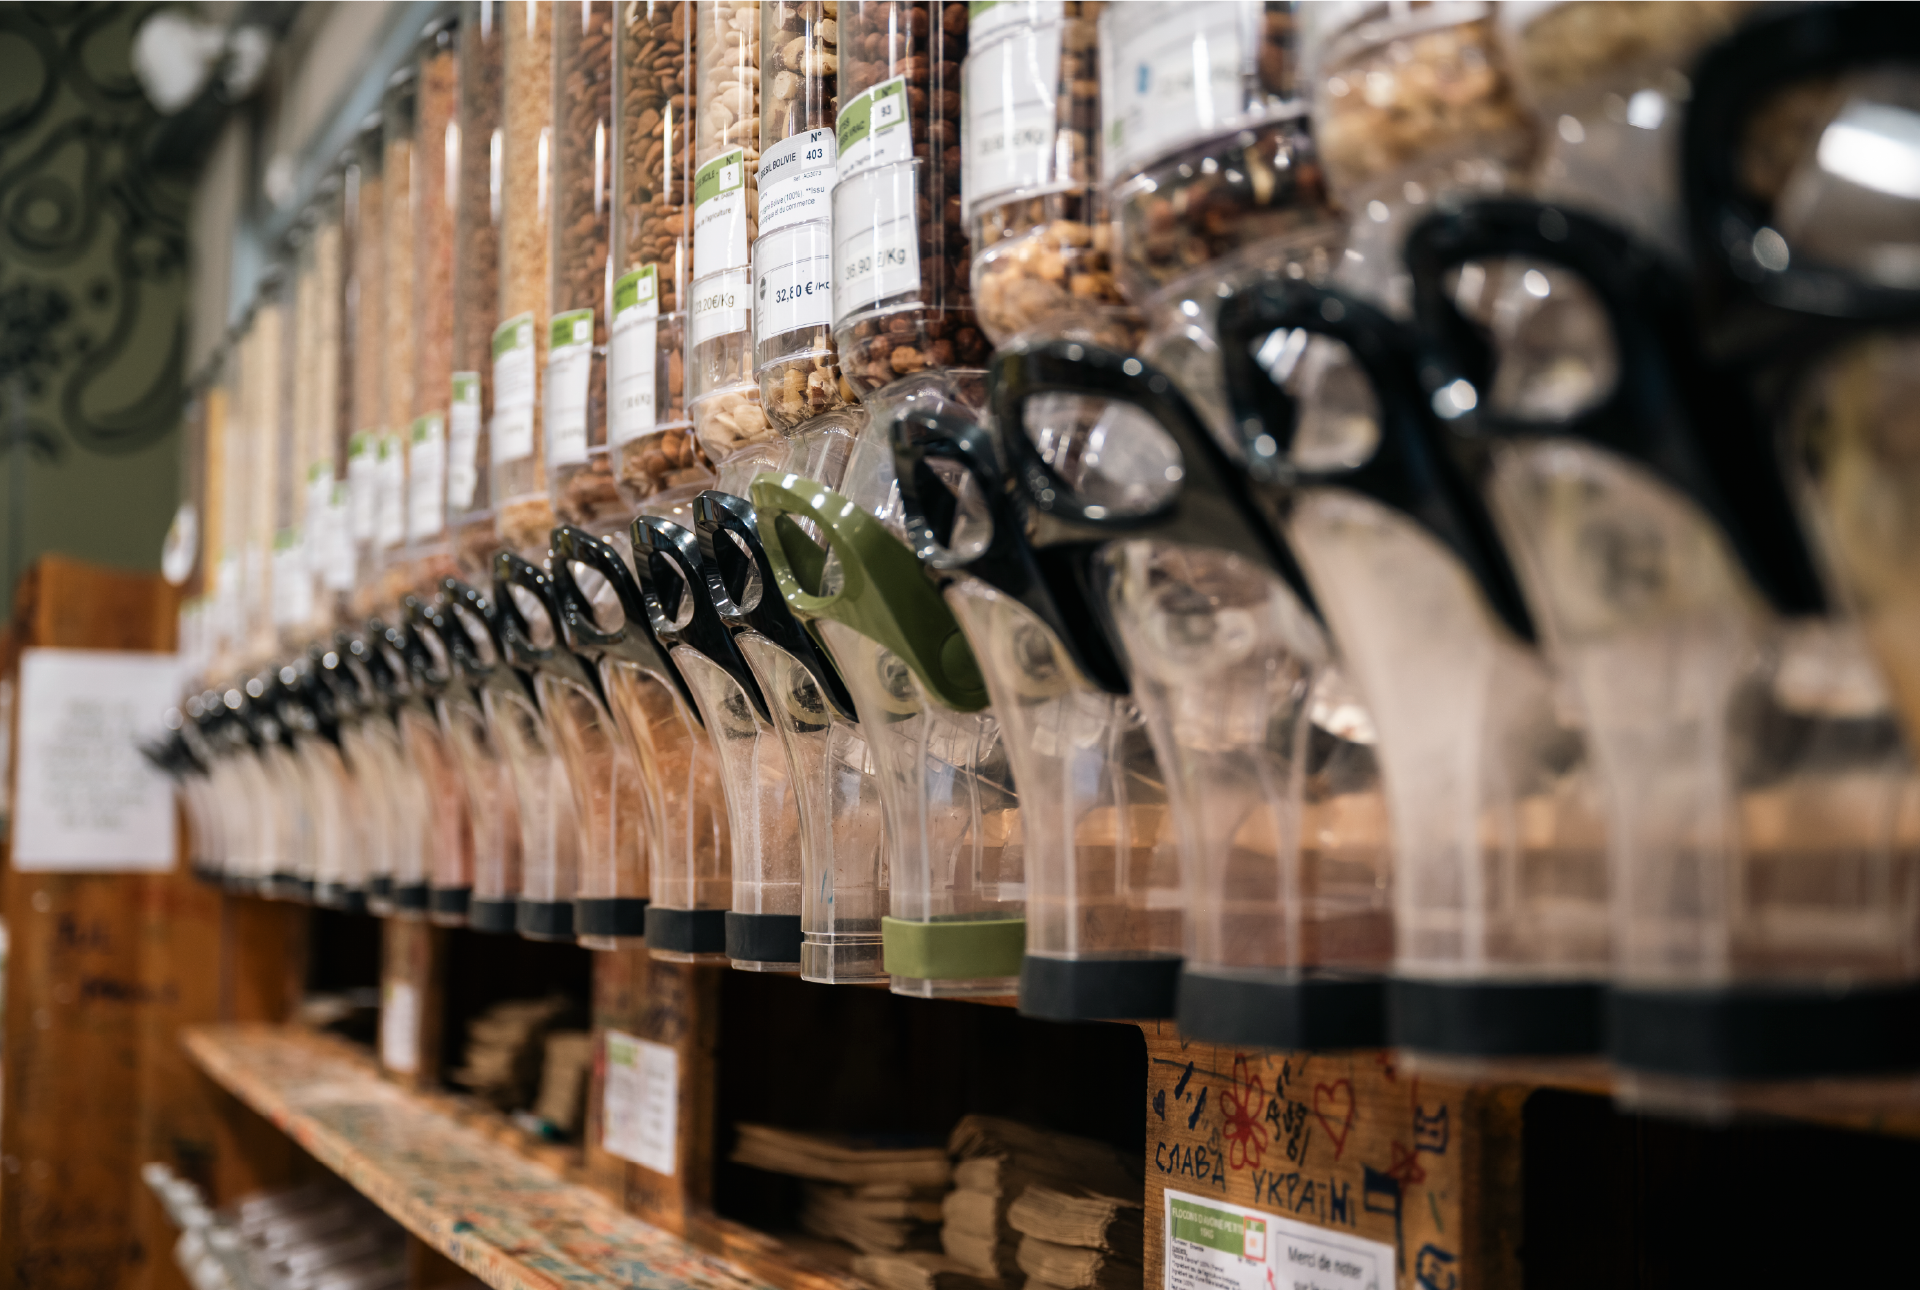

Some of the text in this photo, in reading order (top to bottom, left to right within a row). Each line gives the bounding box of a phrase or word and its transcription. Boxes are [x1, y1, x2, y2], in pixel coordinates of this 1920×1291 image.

[811, 131, 822, 143] N°
[773, 152, 796, 170] BOLIVIE
[806, 148, 823, 160] 403
[786, 198, 815, 212] commerce
[805, 281, 813, 295] €
[1288, 1246, 1315, 1267] Merci
[1318, 1253, 1331, 1272] de
